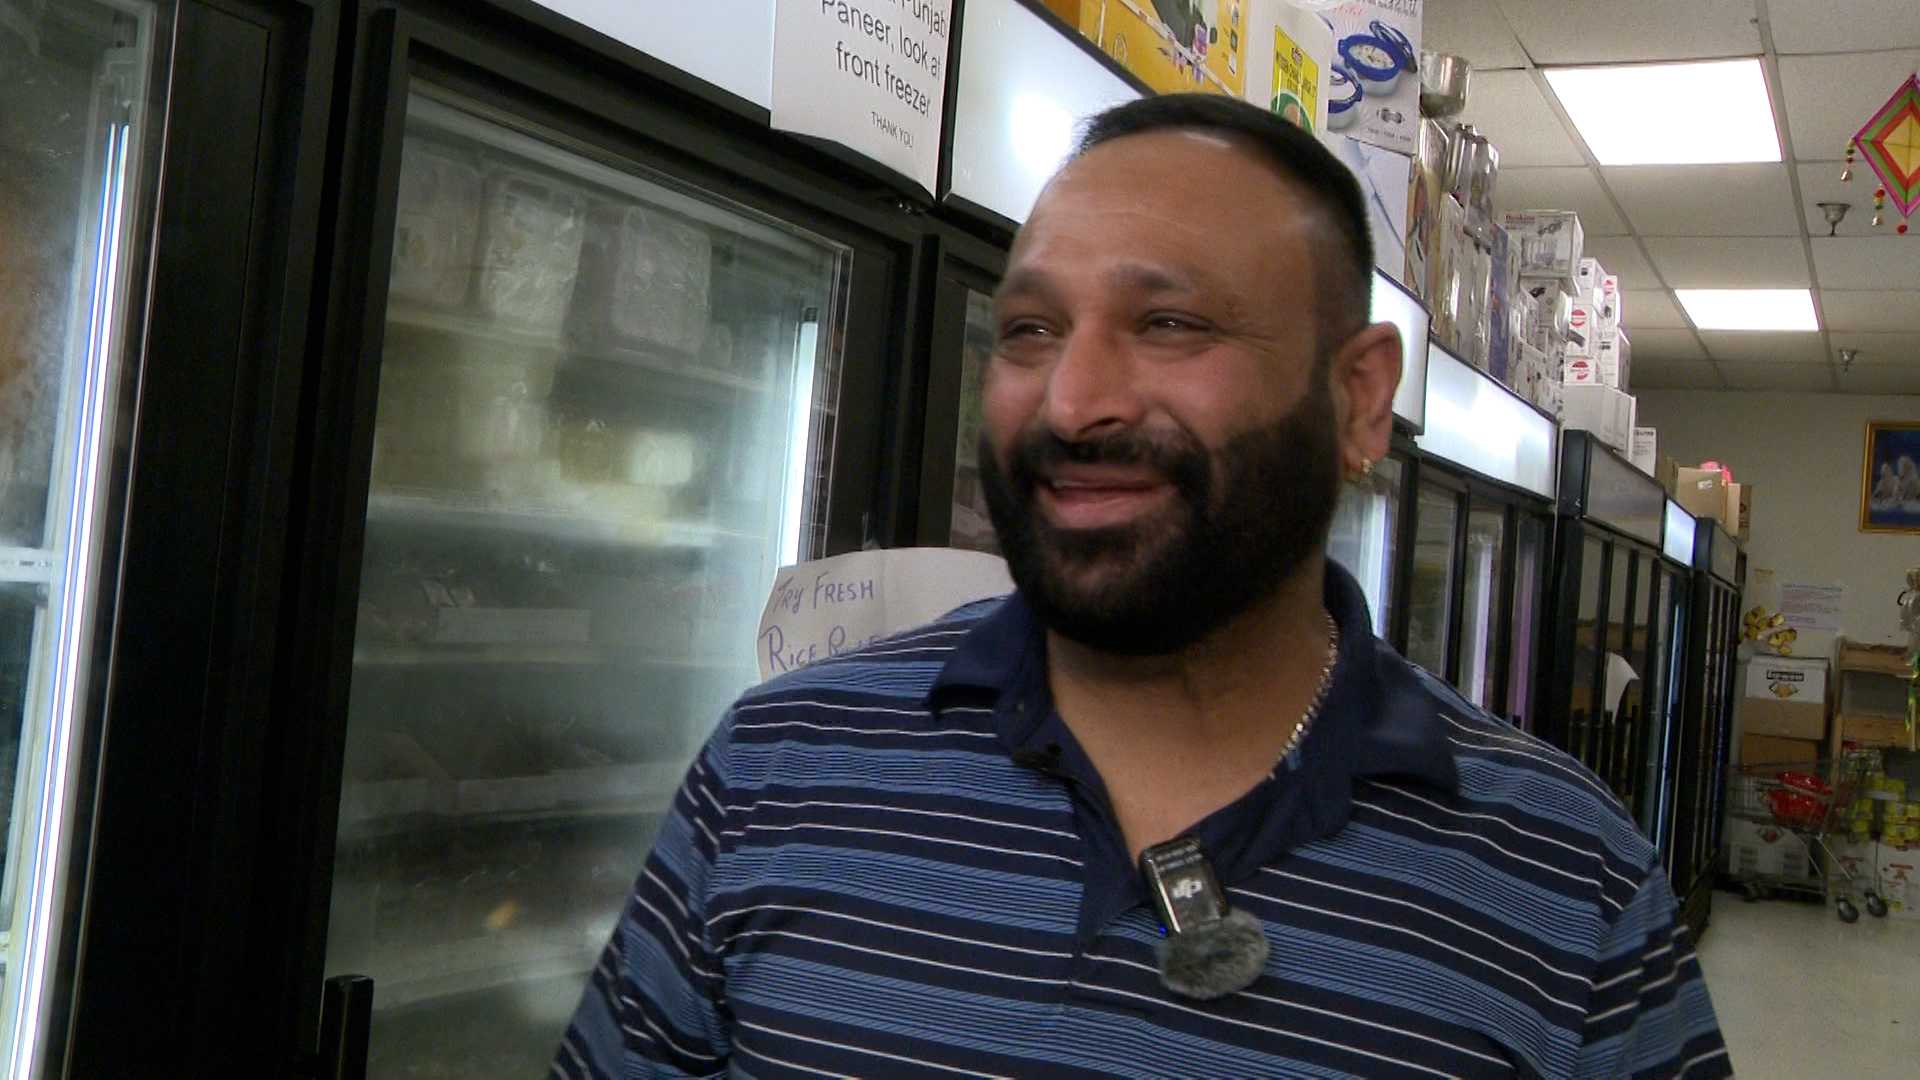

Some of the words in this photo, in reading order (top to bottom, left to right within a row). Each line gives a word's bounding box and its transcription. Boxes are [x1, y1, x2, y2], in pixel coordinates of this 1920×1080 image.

[899, 26, 928, 71] look
[835, 40, 881, 88] front
[883, 64, 931, 118] freezer
[871, 111, 898, 140] THANK
[899, 127, 914, 148] YOU
[813, 570, 874, 610] FRESH
